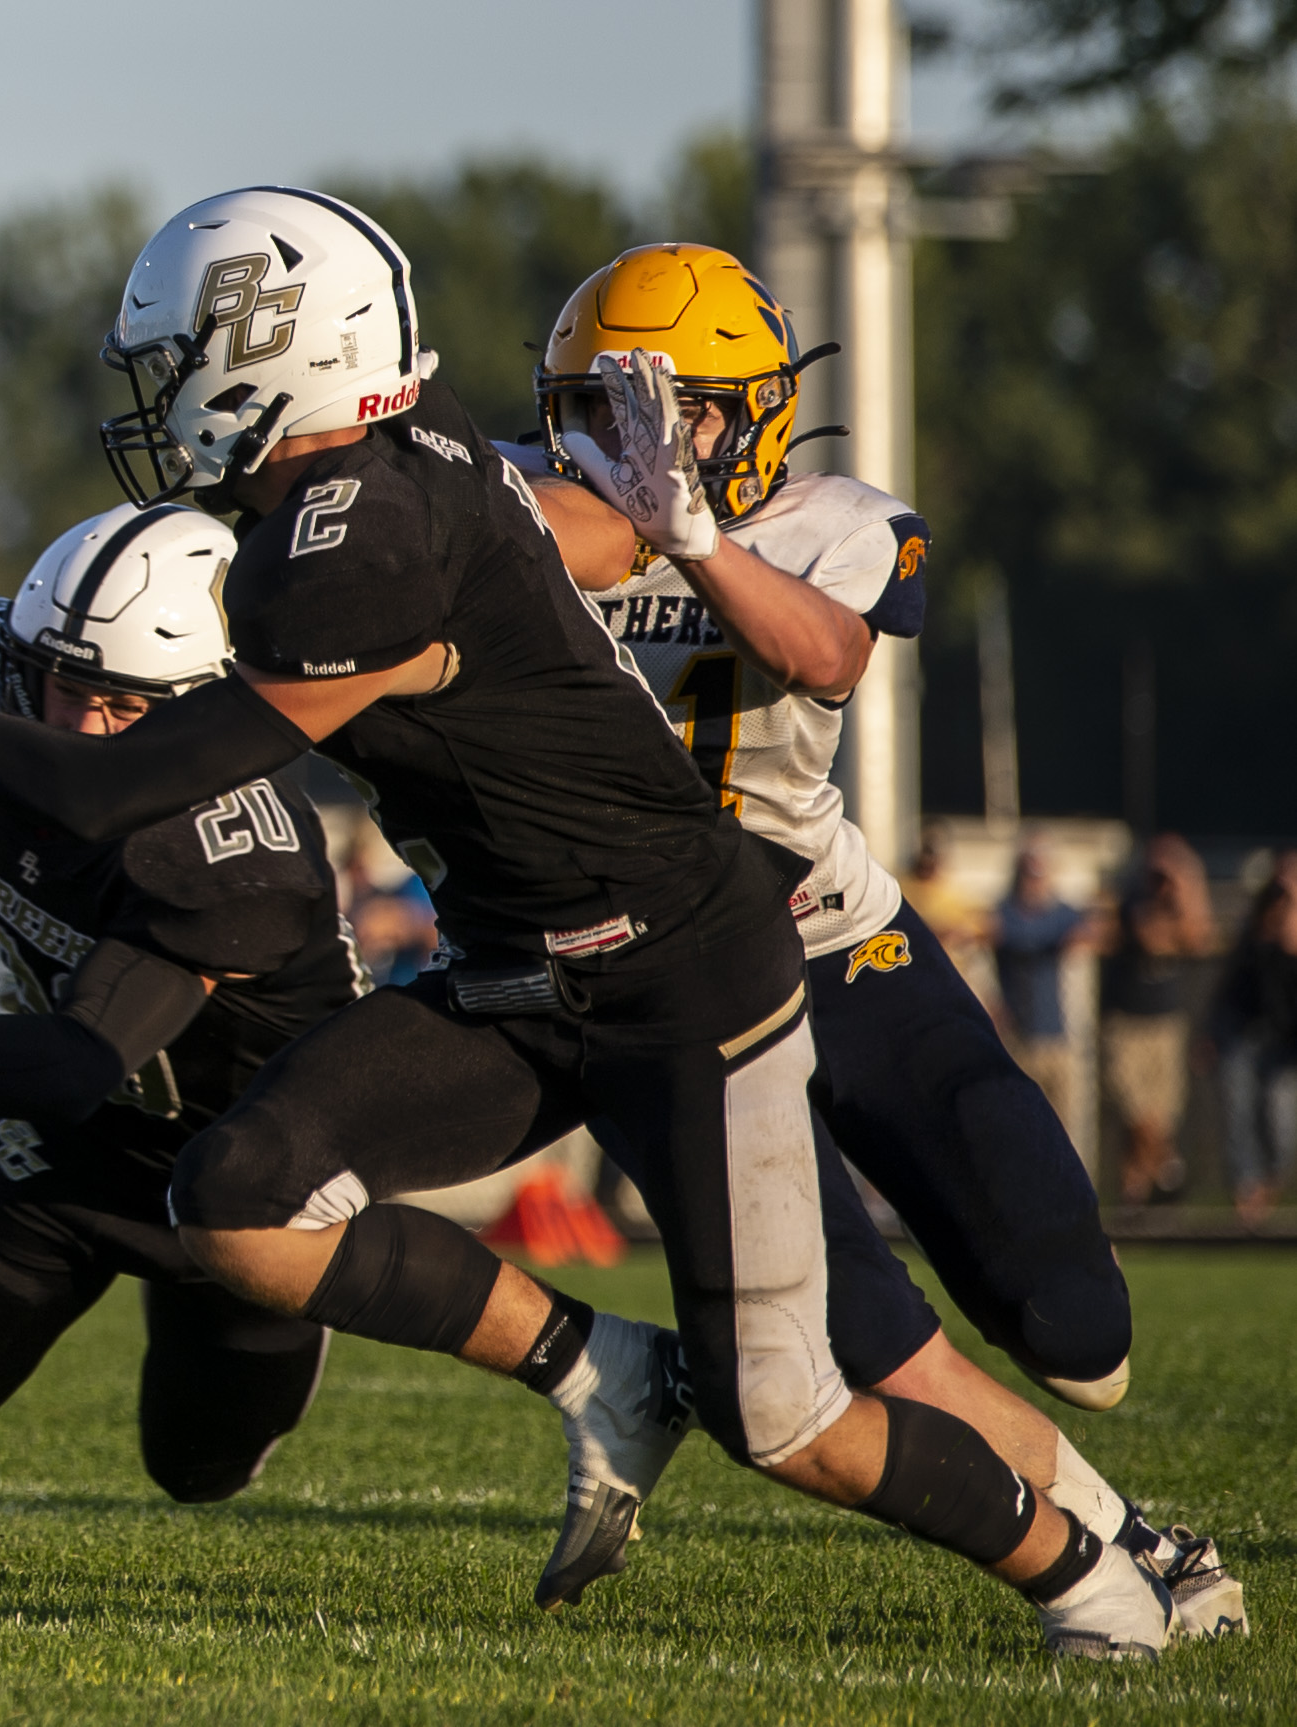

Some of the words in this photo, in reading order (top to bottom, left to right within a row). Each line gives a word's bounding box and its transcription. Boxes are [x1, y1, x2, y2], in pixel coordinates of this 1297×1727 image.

[193, 252, 307, 374] BC
[288, 479, 362, 559] 2
[39, 631, 96, 661] Riddell
[303, 660, 357, 677] Riddell
[190, 777, 301, 865] 20
